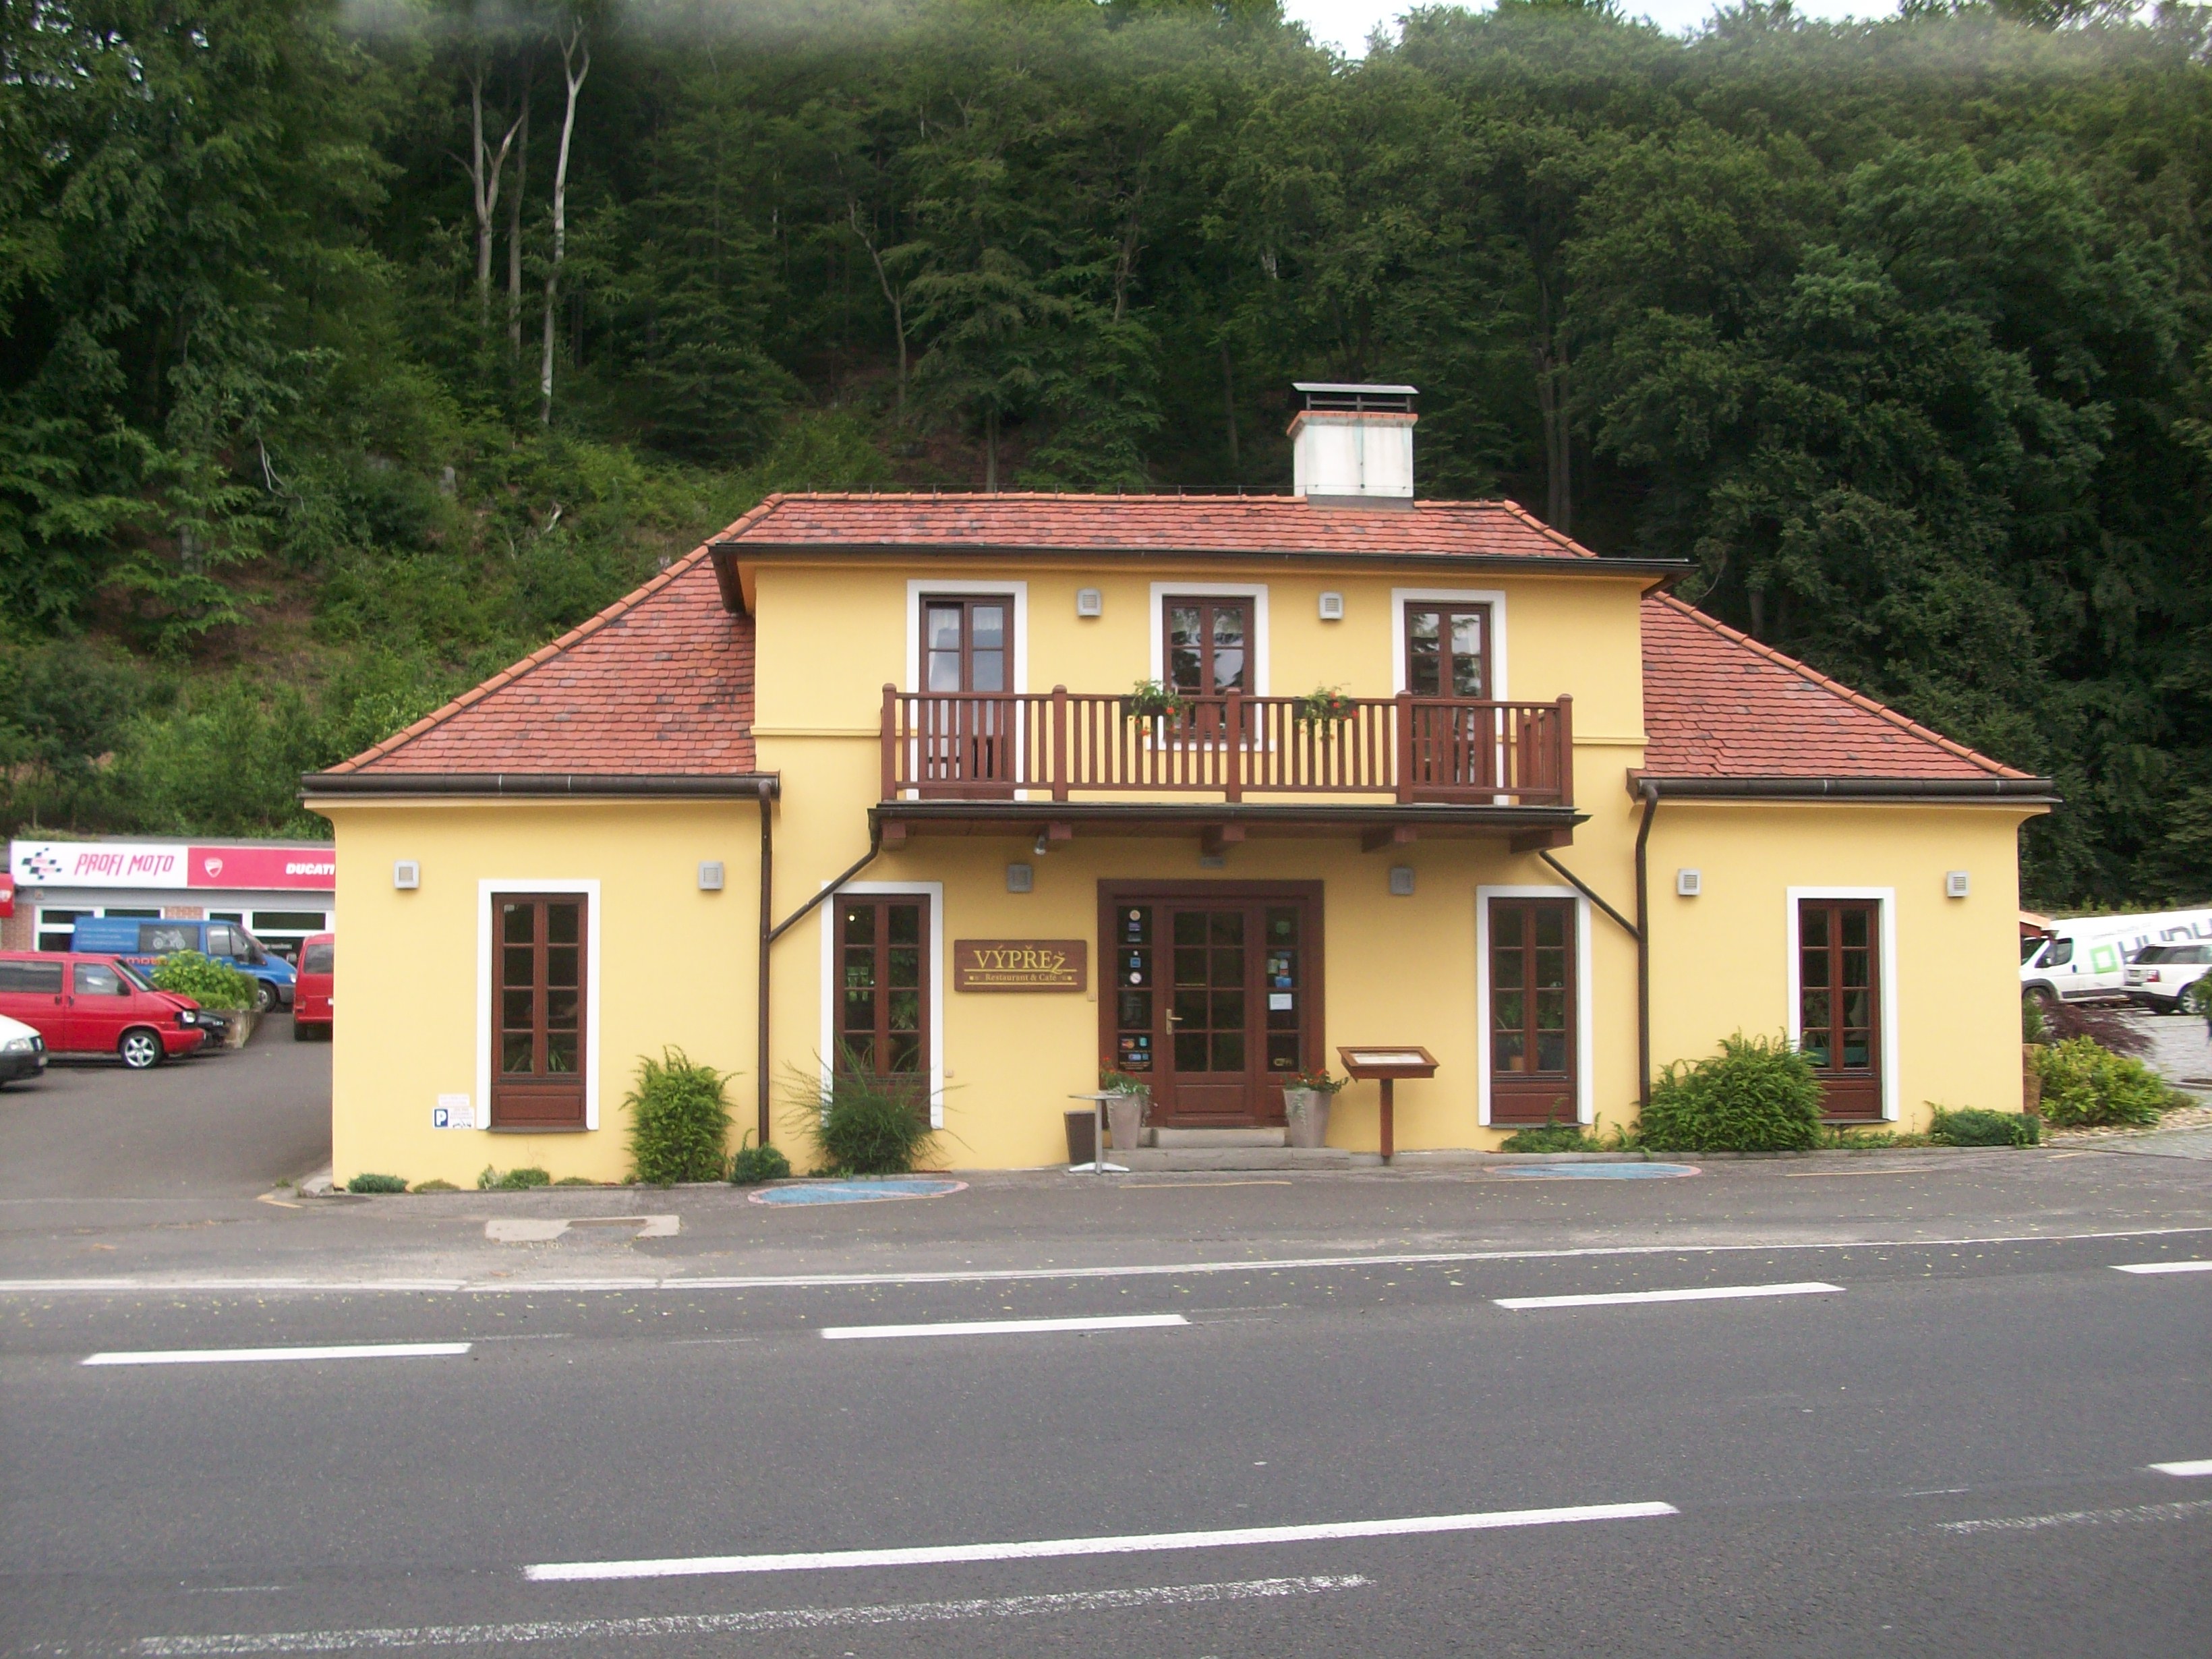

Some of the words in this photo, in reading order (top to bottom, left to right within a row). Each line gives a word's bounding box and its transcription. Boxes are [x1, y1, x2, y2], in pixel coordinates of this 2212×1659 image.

[74, 854, 123, 875] PROFI
[127, 855, 175, 875] MOTO
[285, 863, 335, 875] DUCATI
[436, 1110, 446, 1126] P
